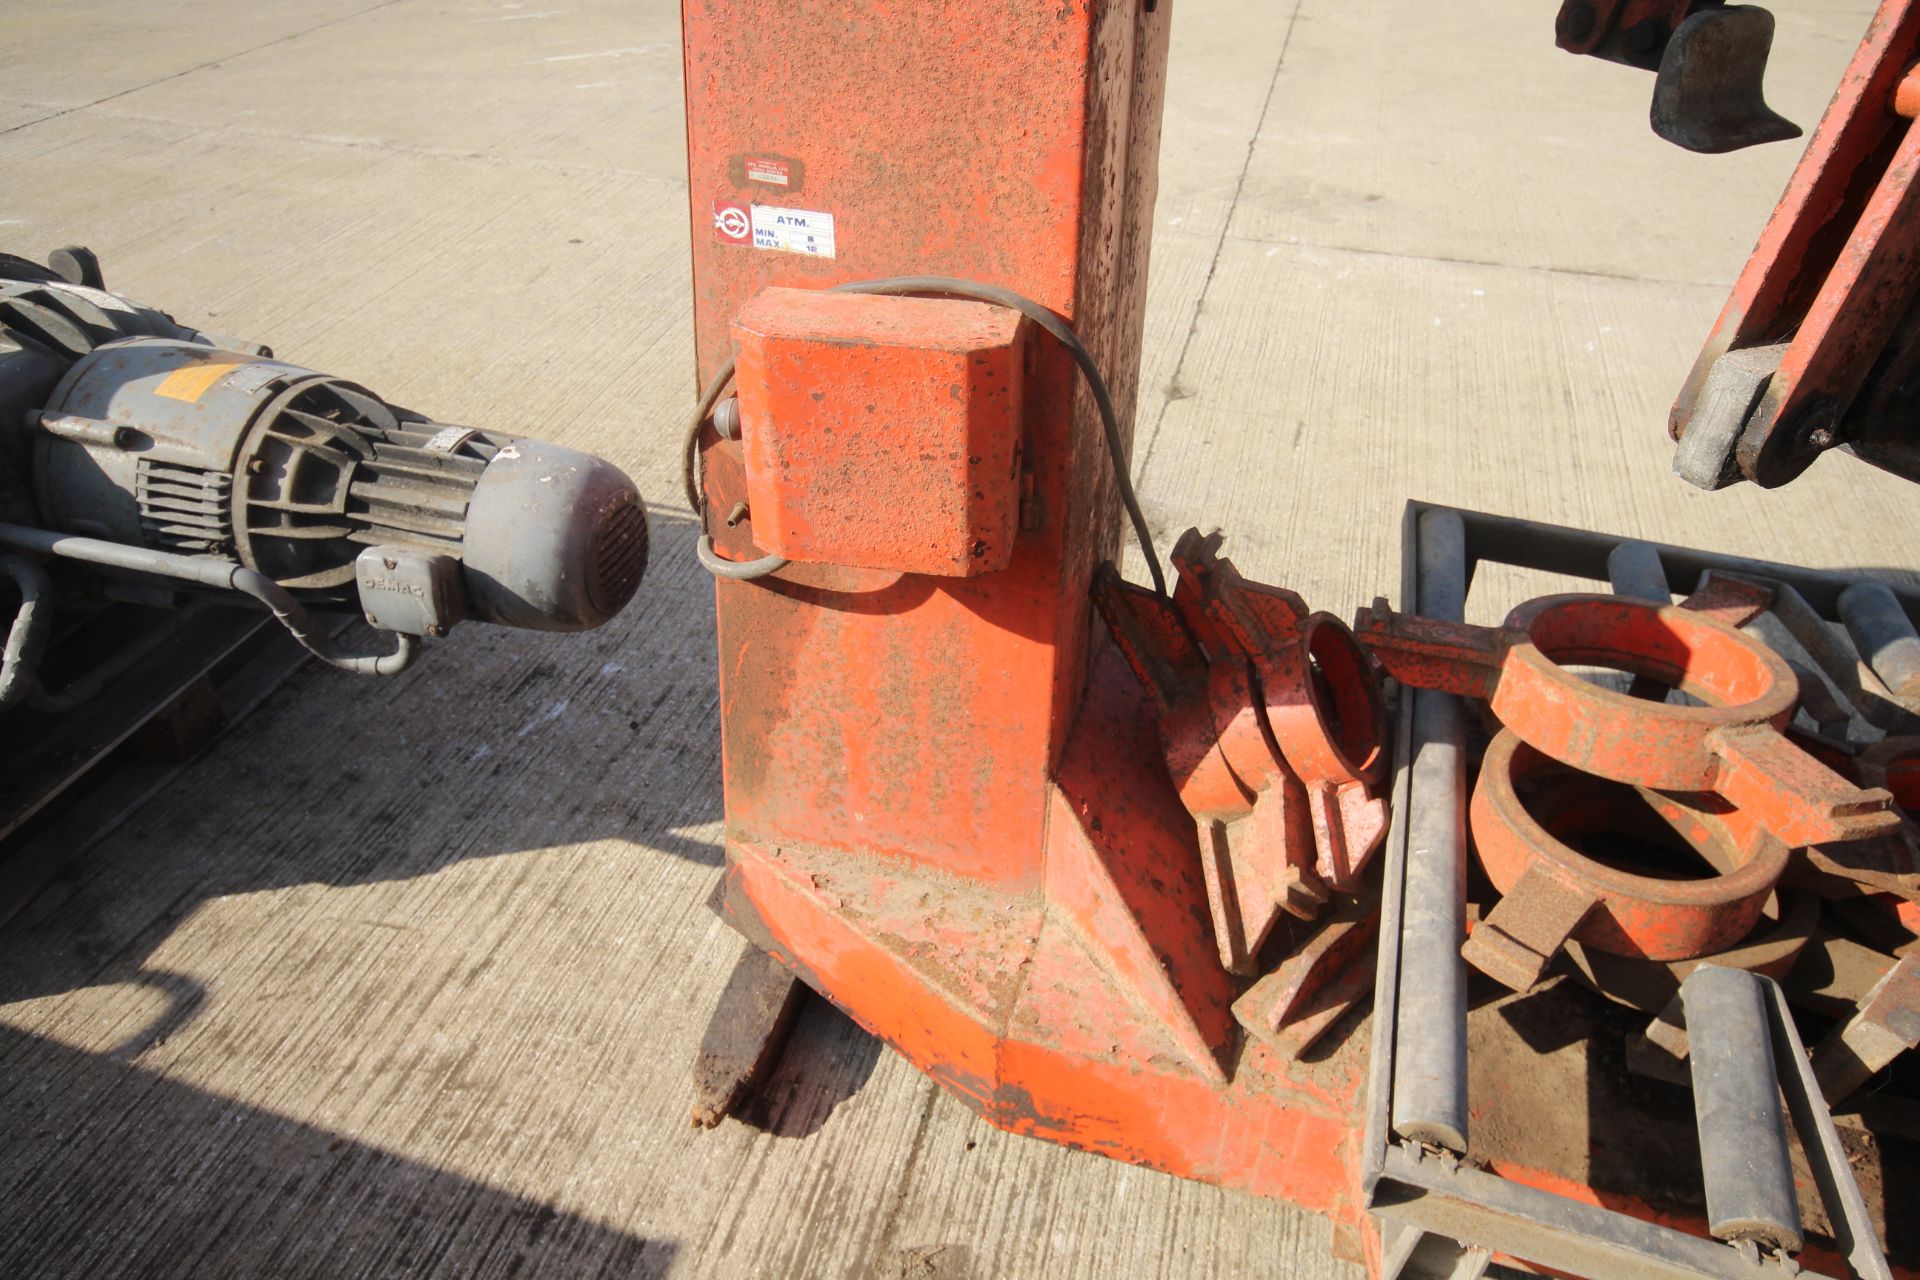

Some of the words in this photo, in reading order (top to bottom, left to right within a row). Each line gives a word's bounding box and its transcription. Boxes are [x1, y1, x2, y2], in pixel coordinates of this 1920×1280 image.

[777, 216, 810, 228] ATM.
[755, 228, 778, 239] MIN.
[756, 238, 784, 249] MAX.
